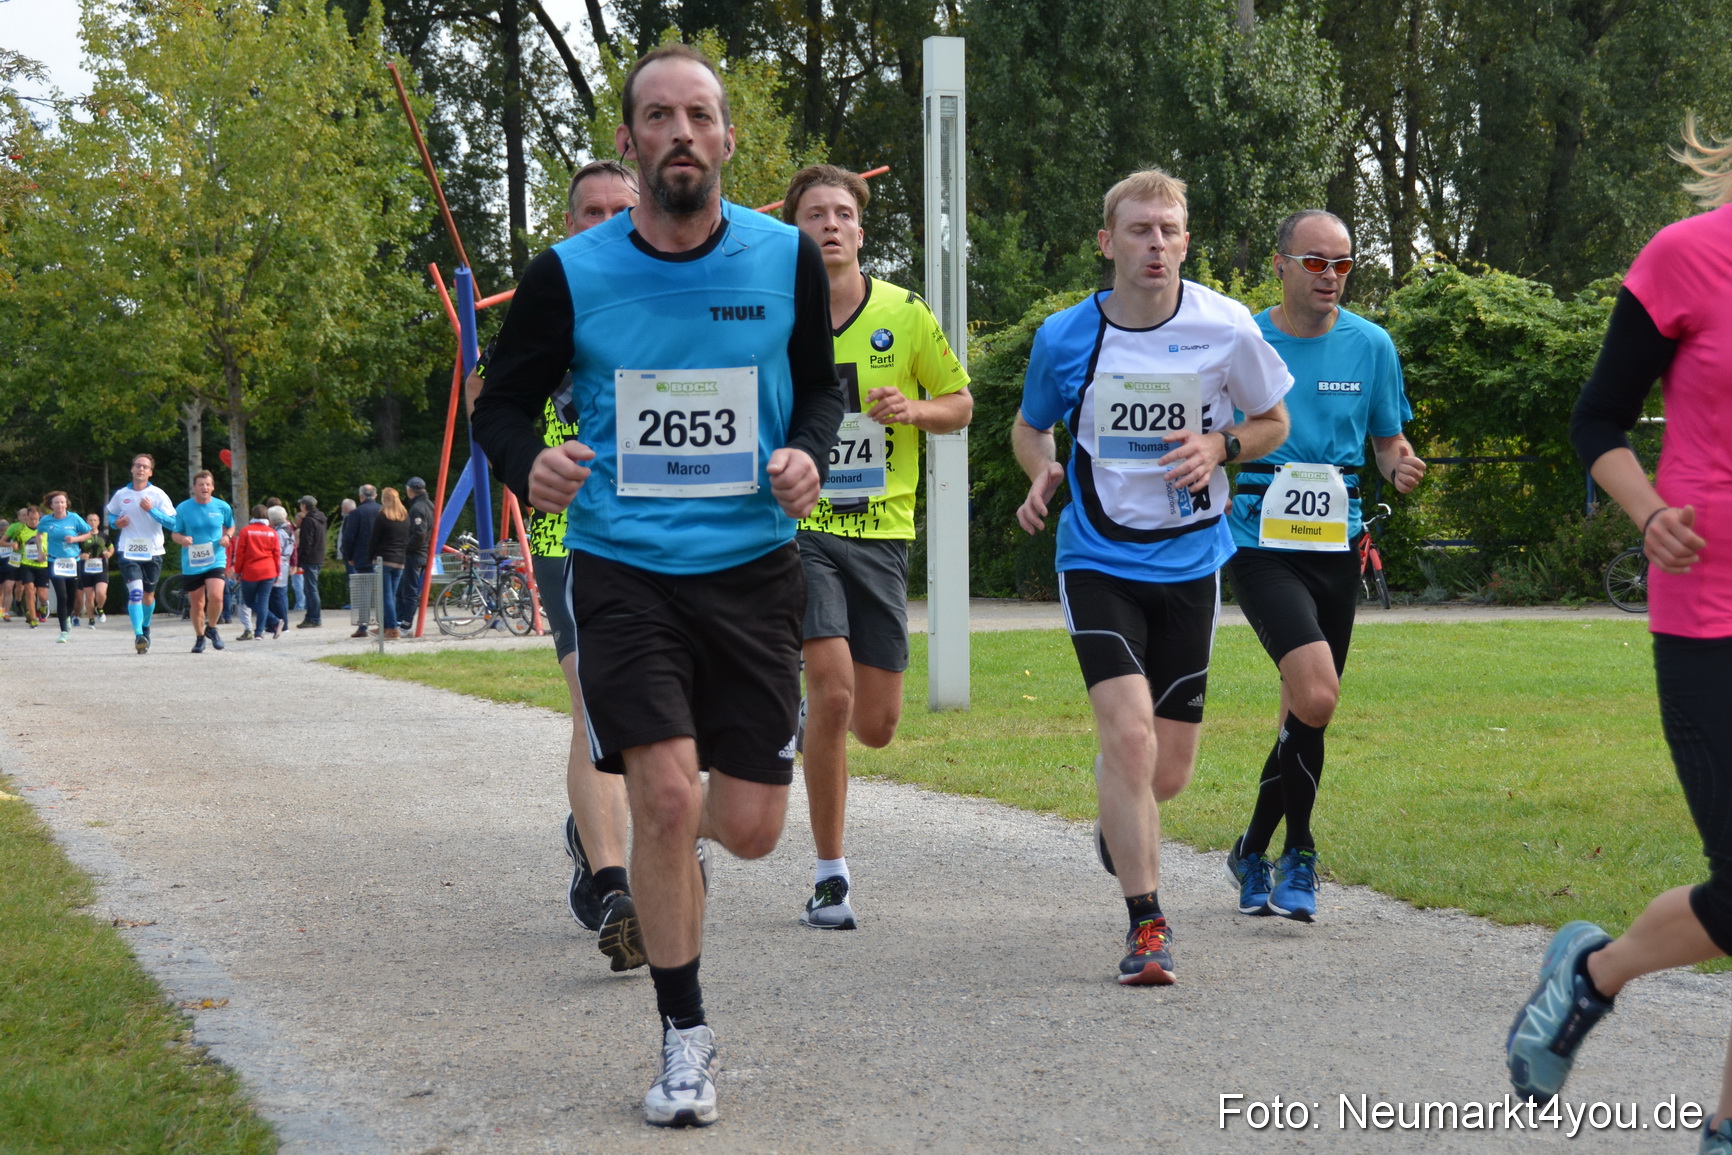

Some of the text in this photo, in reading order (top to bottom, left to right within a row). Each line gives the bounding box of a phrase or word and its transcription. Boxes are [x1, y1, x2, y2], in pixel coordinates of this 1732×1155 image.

[710, 305, 766, 321] THULE
[870, 354, 895, 365] Partl
[670, 381, 718, 393] BOCK
[1134, 382, 1171, 391] BOCK
[1317, 380, 1362, 392] BOCK
[1110, 403, 1186, 431] 2028
[638, 408, 737, 448] 2653
[625, 441, 631, 449] C
[1128, 441, 1170, 453] Thomas
[667, 461, 711, 476] Marco
[826, 473, 862, 484] eonhard
[1300, 471, 1329, 480] BOCK
[1284, 489, 1331, 517] 203
[1291, 524, 1322, 536] Helmut
[128, 544, 149, 552] 2285
